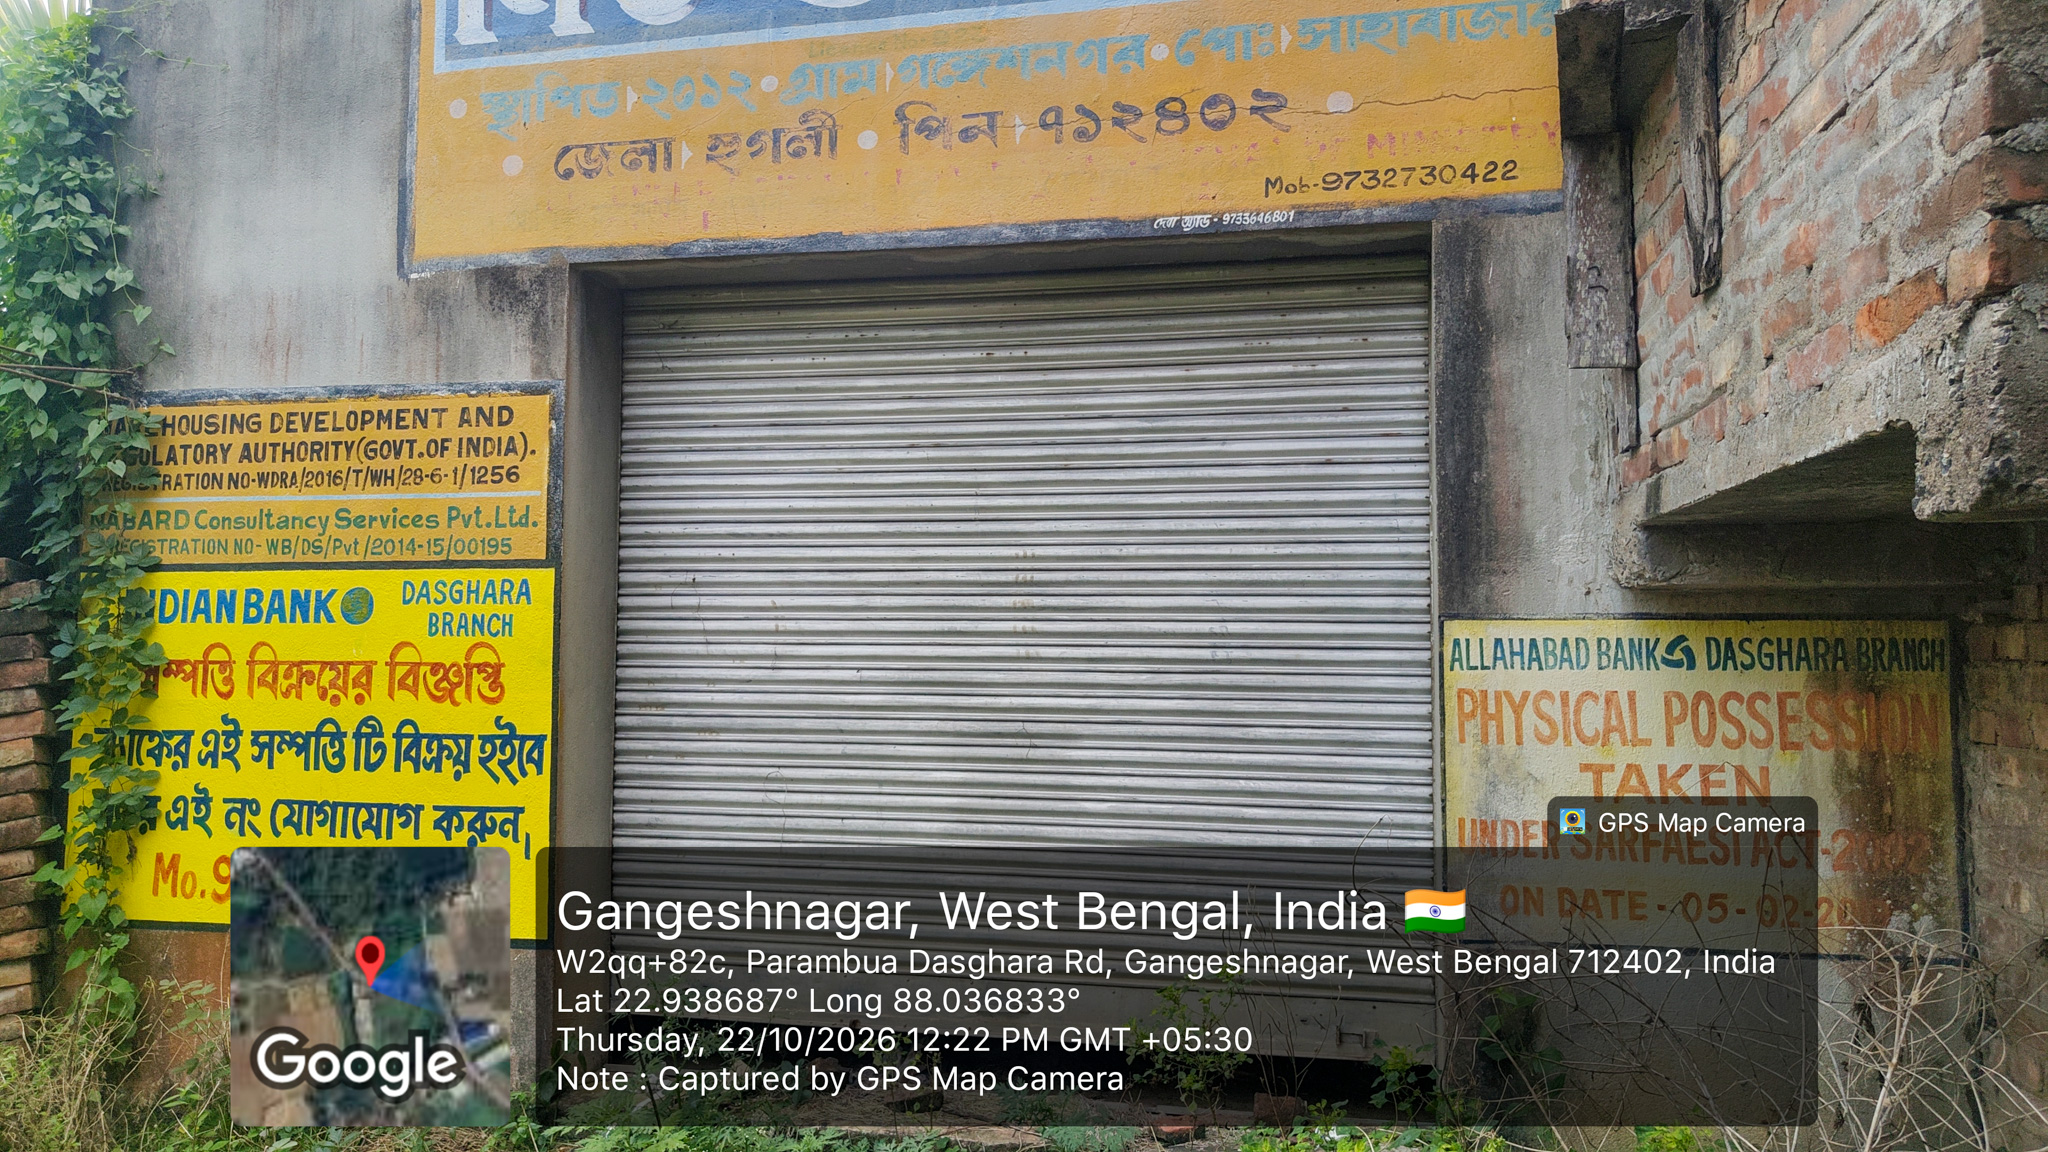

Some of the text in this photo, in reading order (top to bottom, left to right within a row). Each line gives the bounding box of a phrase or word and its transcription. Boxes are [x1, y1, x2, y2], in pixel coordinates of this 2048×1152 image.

[479, 70, 622, 142] স্থাপিত
[642, 70, 758, 121] ২০১২
[779, 58, 882, 106] গ্রাম
[1174, 22, 1275, 67] পোঃ
[553, 88, 1292, 181] জেলা হুগলী পিন ৭১২৪০২
[1222, 210, 1295, 225] 9733646801
[270, 408, 449, 434] DEVELOPMENT
[457, 406, 514, 428] AND
[457, 431, 537, 463] INDIA).
[194, 508, 330, 536] Consultancy
[334, 507, 440, 529] Services
[447, 505, 538, 528] Pvt.Ltd.
[242, 588, 339, 624] BANK
[401, 578, 533, 606] DASGHARA
[427, 612, 514, 638] BRANCH
[1450, 636, 1945, 673] ALLAHABAD BANK DASGHARA BRANCH
[246, 641, 377, 707] বিক্রয়ের
[1457, 687, 1940, 751] PHYSICAL POSSESSION
[197, 712, 244, 774] এই
[250, 717, 348, 774] সম্পত্তি
[392, 718, 474, 782] বিক্রয়
[478, 715, 548, 786] হইবে
[1579, 762, 1771, 807] TAKEN
[165, 782, 213, 839] এই
[222, 797, 262, 839] নং
[269, 799, 425, 841] যোগাযোগ
[1457, 816, 1560, 860] UNDER
[1570, 823, 1741, 868] SARFAESI
[1500, 884, 1545, 917] ON
[1557, 886, 1648, 921] DATE
